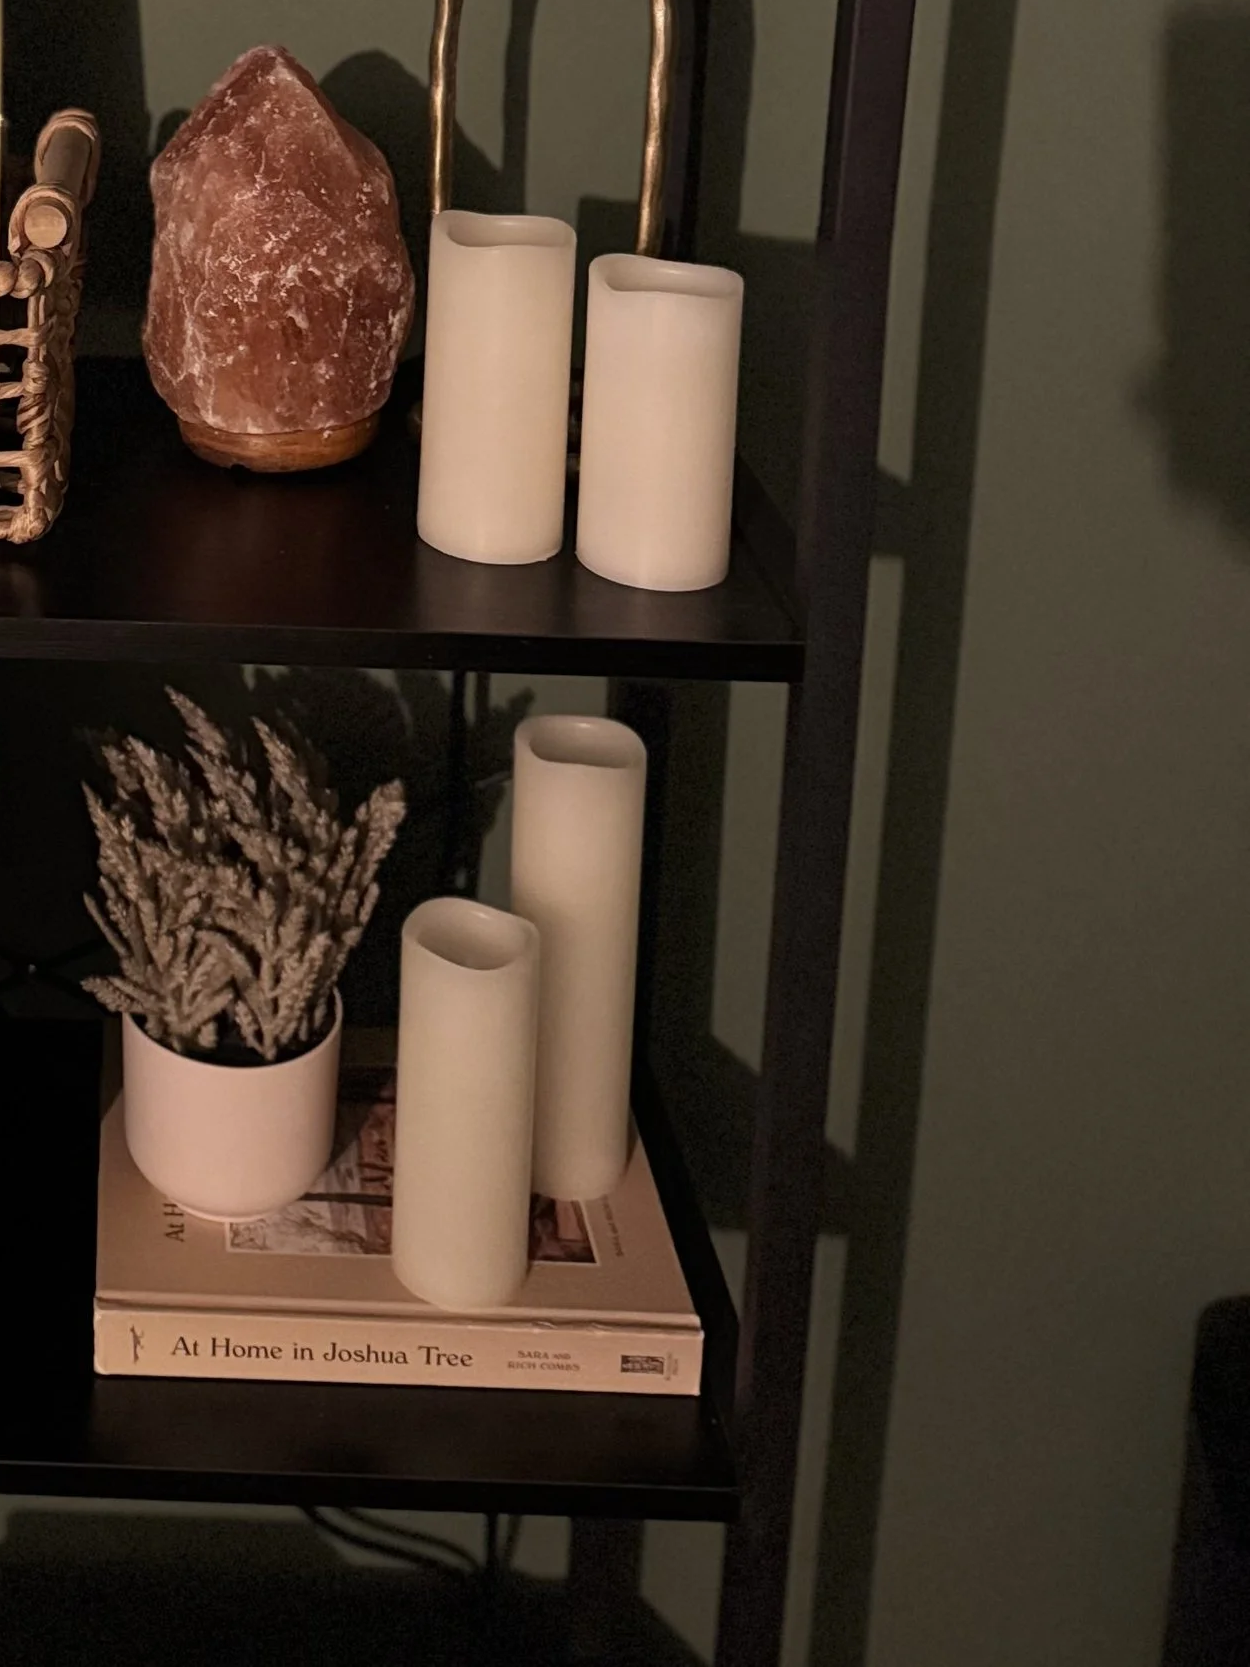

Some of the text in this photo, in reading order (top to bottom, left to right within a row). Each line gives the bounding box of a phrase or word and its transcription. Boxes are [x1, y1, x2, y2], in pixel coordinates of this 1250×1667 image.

[170, 1336, 474, 1367] At Home in Joshua Tree
[517, 1350, 549, 1360] SARA
